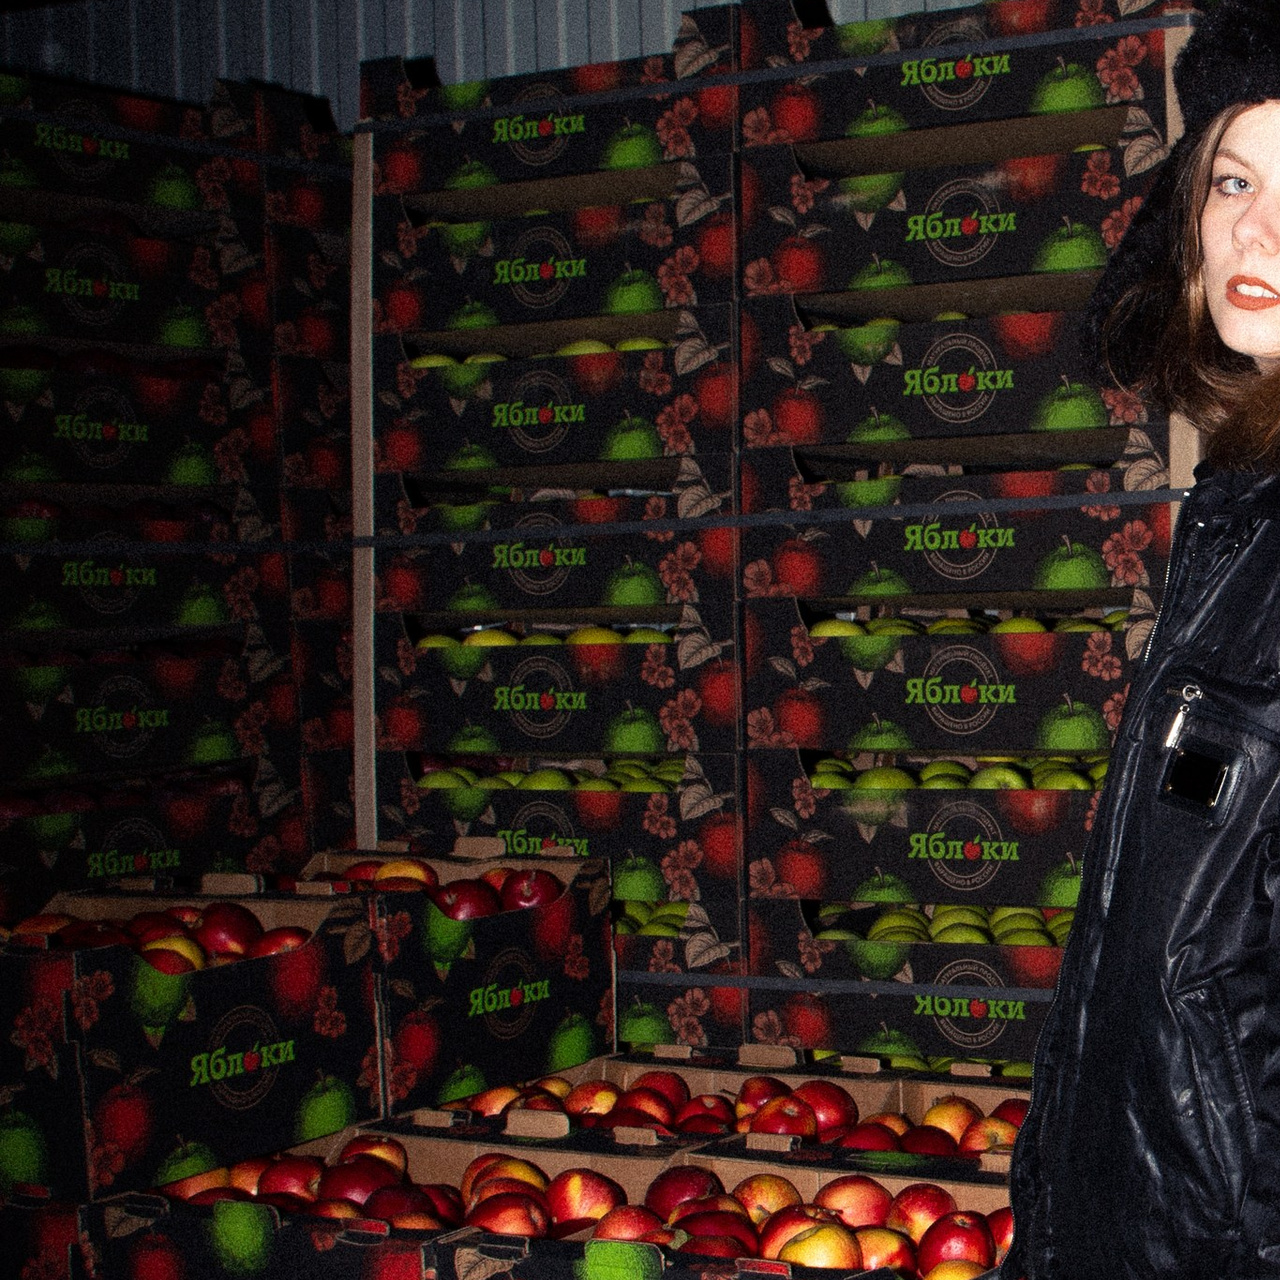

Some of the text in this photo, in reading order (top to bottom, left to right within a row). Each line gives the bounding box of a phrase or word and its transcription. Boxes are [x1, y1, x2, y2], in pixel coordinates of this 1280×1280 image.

[901, 55, 1011, 87] Яблоки
[494, 114, 586, 143] Яблоки
[905, 212, 1016, 243] Яблоки
[495, 257, 587, 284] Яблоки
[904, 366, 1014, 396] Яблоки
[493, 401, 586, 428] Яблоки
[905, 523, 1015, 551] Яблоки
[494, 542, 587, 568] Яблоки
[495, 685, 587, 711] Яблоки
[906, 677, 1016, 704] Яблоки
[909, 832, 1019, 861] Яблоки
[469, 979, 550, 1016] Яблоки
[191, 1039, 296, 1086] Яблоки
